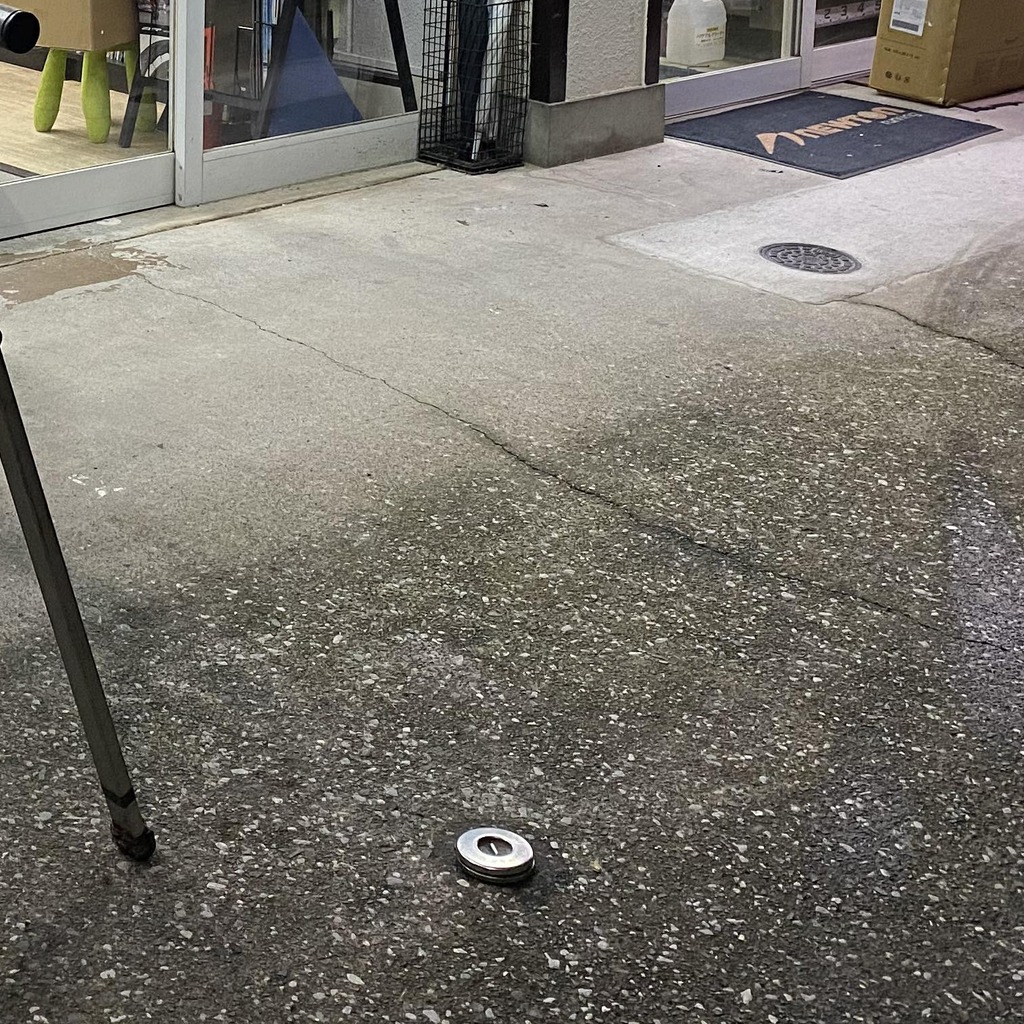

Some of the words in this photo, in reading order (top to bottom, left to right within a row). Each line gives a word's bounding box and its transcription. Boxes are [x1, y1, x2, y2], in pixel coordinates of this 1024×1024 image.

[824, 9, 831, 19] 2
[840, 6, 848, 16] 3
[857, 2, 865, 12] 4
